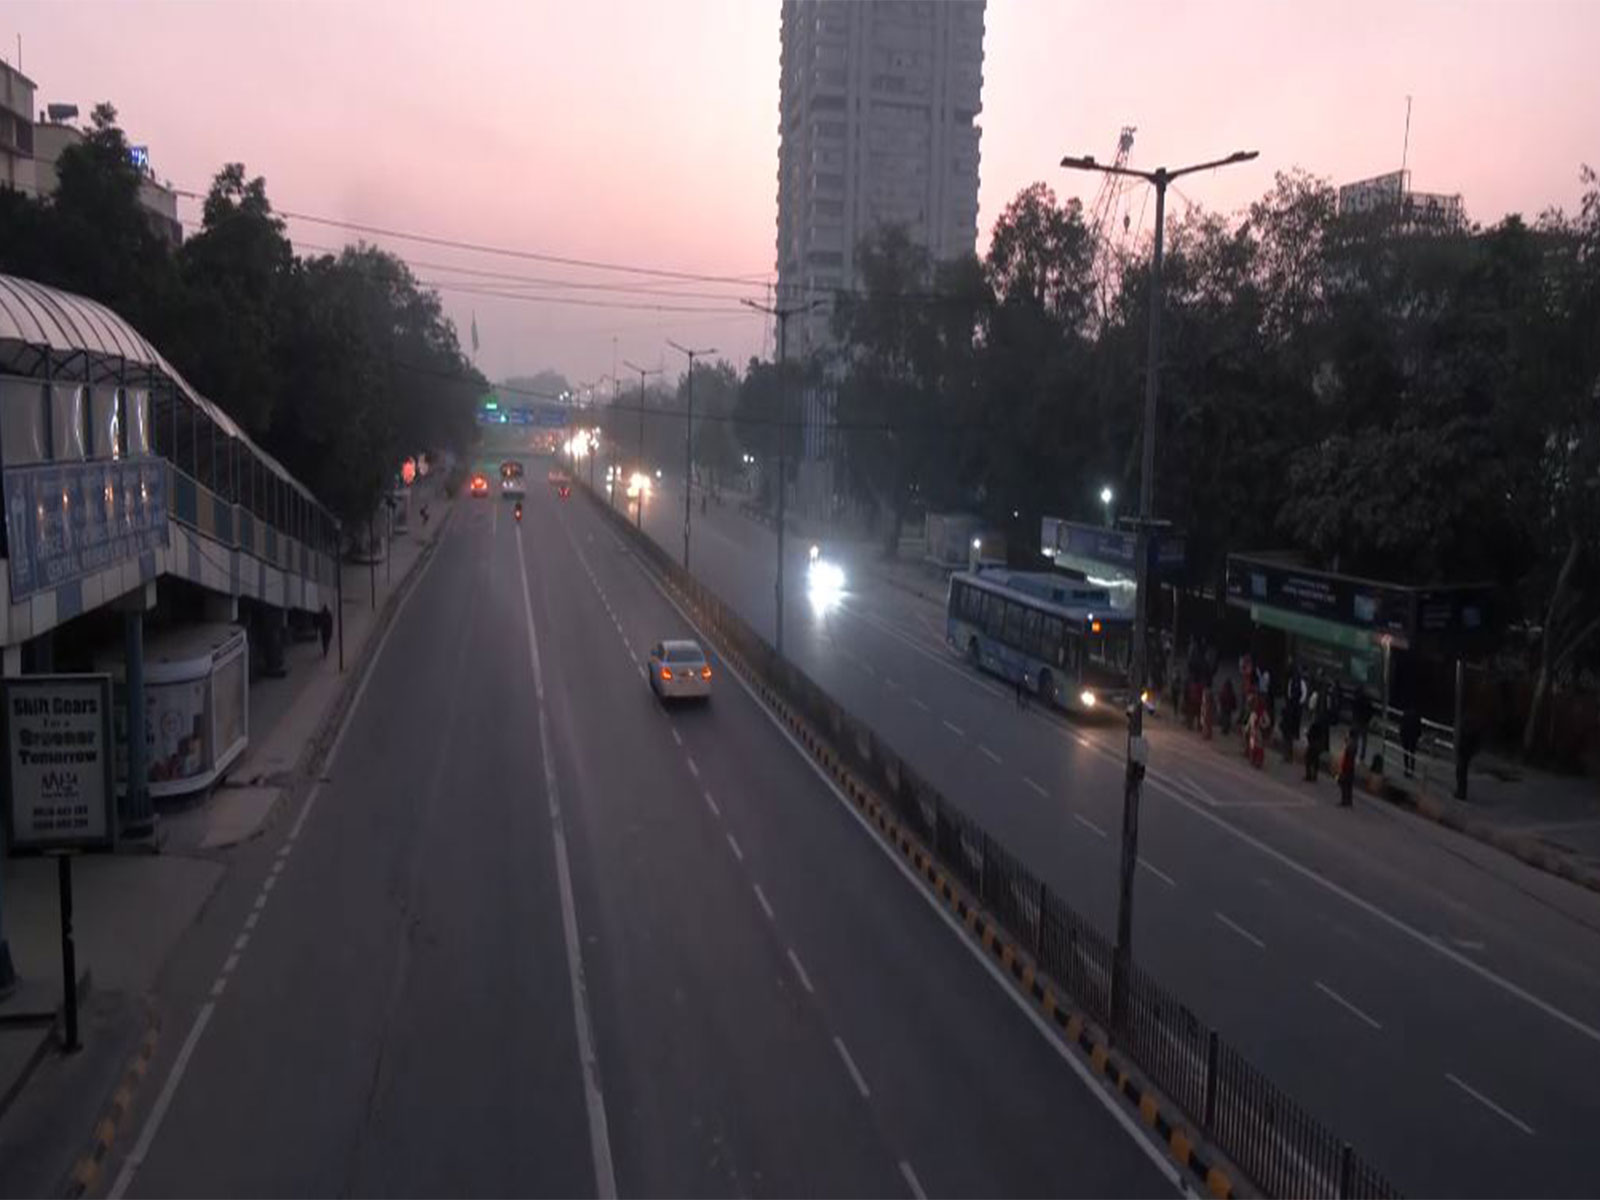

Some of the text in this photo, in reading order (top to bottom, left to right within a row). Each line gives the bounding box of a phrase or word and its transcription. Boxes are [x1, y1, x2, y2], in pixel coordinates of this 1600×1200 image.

[14, 697, 97, 716] Shift Gears
[19, 728, 95, 746] Greener
[18, 749, 97, 765] Tomorrow
